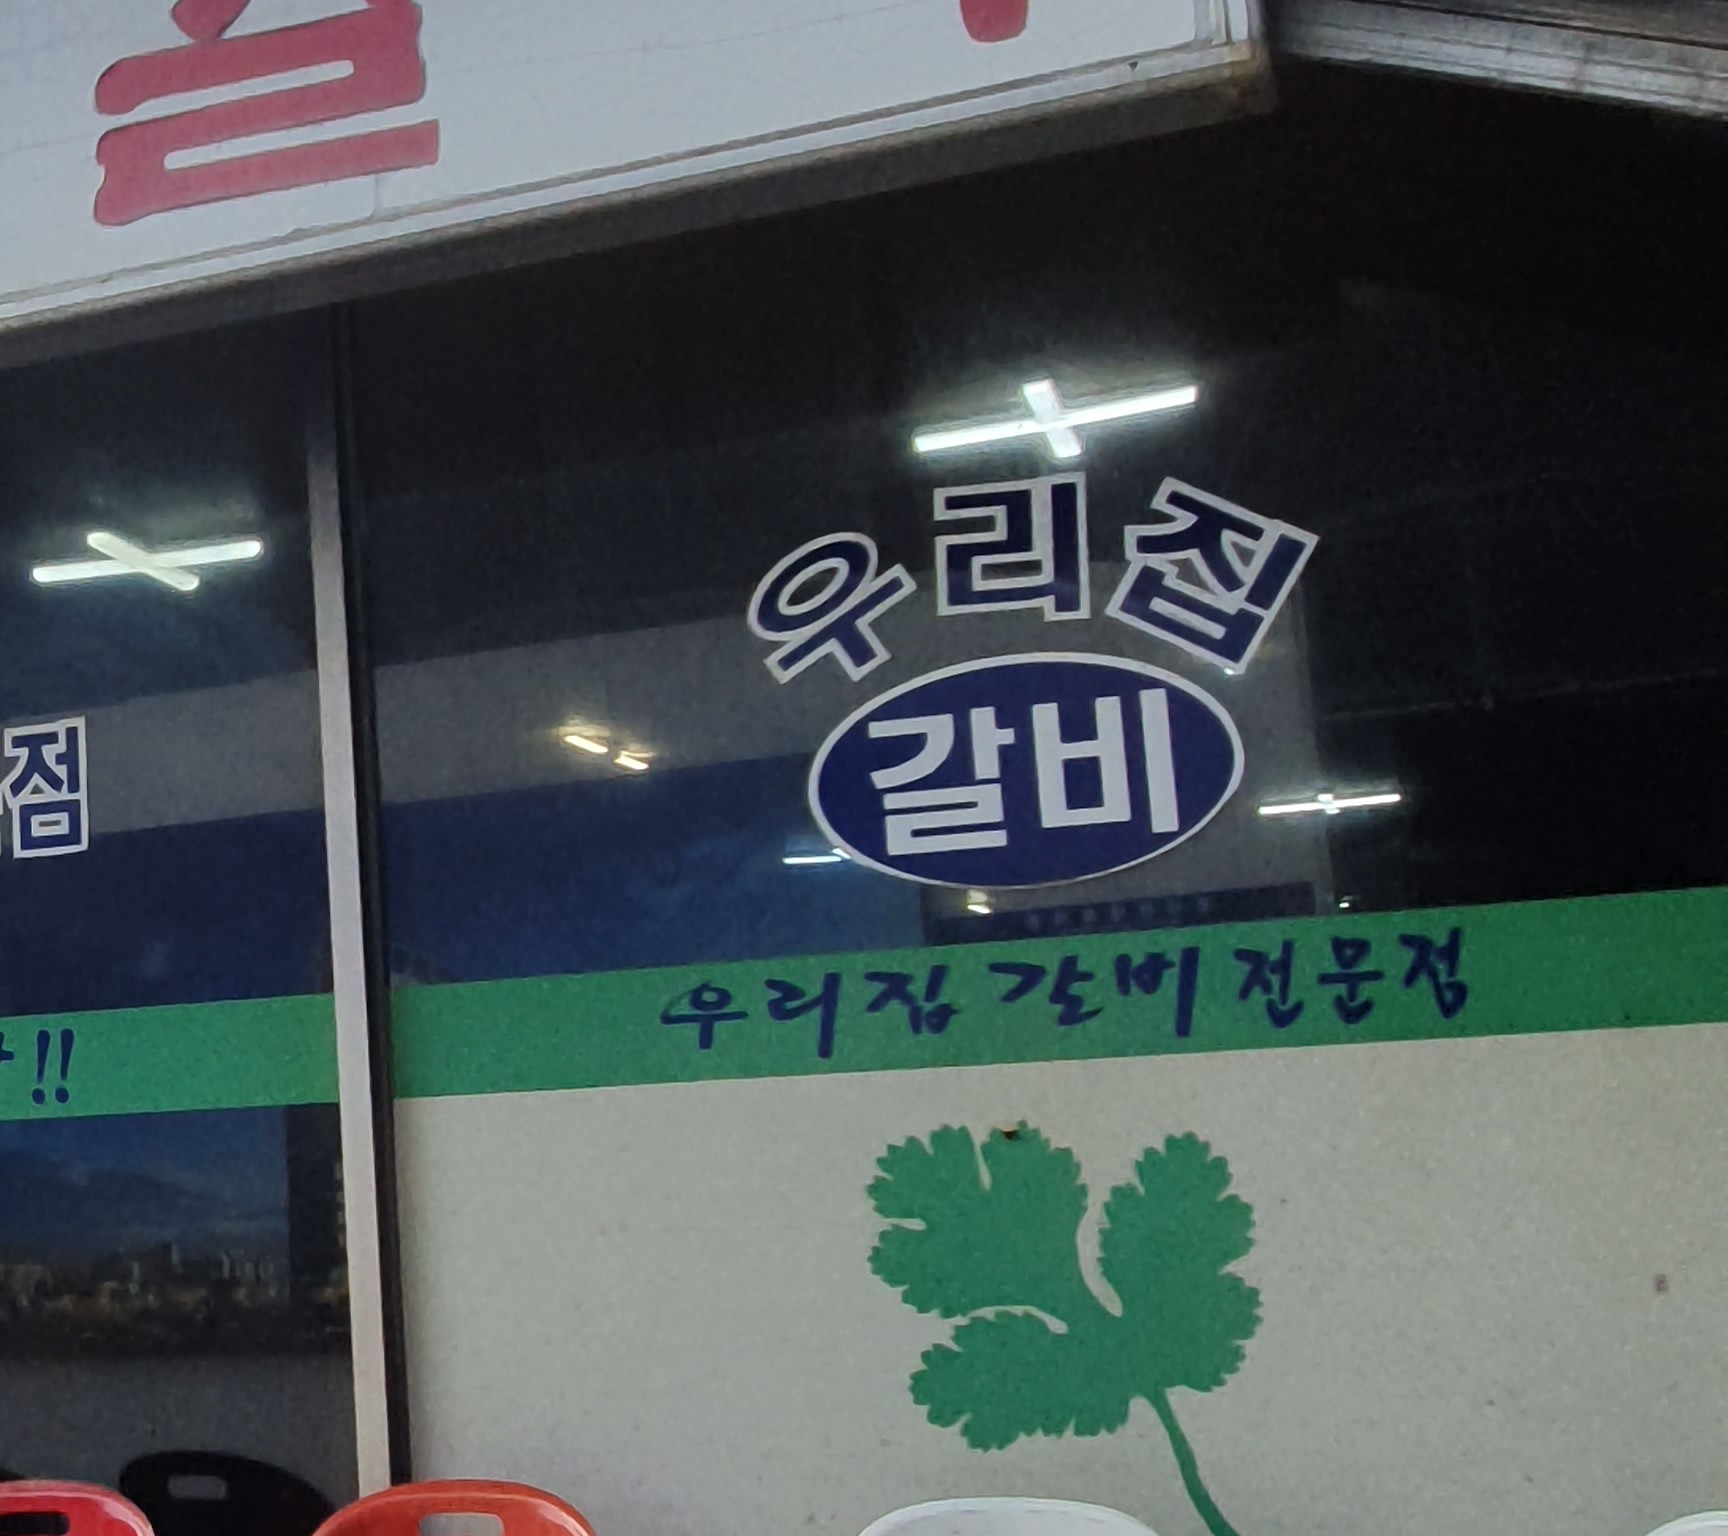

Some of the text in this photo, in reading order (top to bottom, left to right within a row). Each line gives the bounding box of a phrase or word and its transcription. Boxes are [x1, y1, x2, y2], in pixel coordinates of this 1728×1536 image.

[747, 470, 1320, 686] 우리집
[868, 688, 1180, 857] 갈비
[1233, 927, 1472, 1029] 전문점
